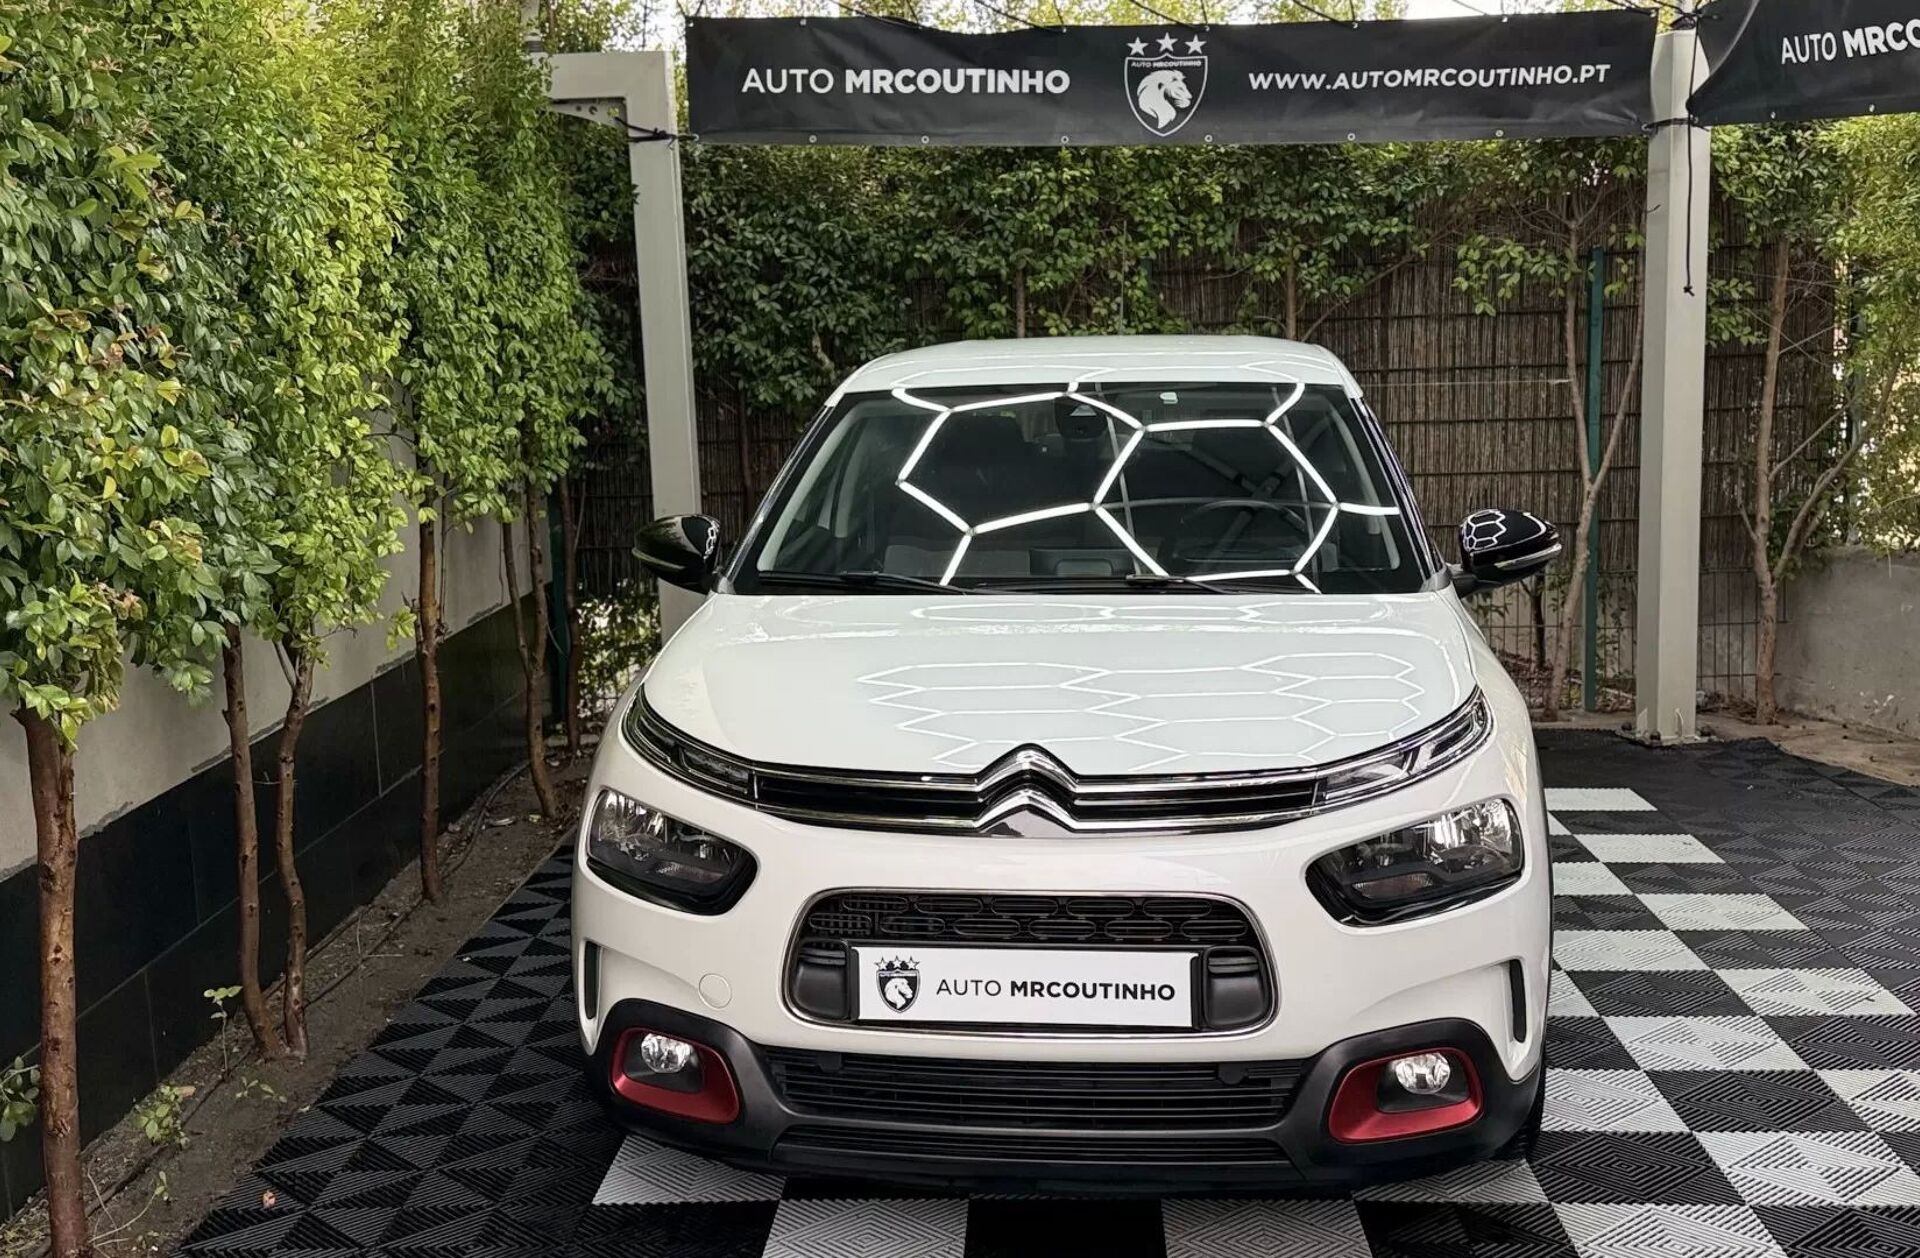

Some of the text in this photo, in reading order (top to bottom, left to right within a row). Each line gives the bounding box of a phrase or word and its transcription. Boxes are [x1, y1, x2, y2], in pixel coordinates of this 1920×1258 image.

[1781, 32, 1837, 65] AUTO
[741, 68, 1071, 94] AUTO MRCOUTINHO
[1248, 64, 1611, 91] WWW.AUTOMRCOUTINHO.PT
[936, 978, 1176, 1001] AUTO MRCOUTINHO
